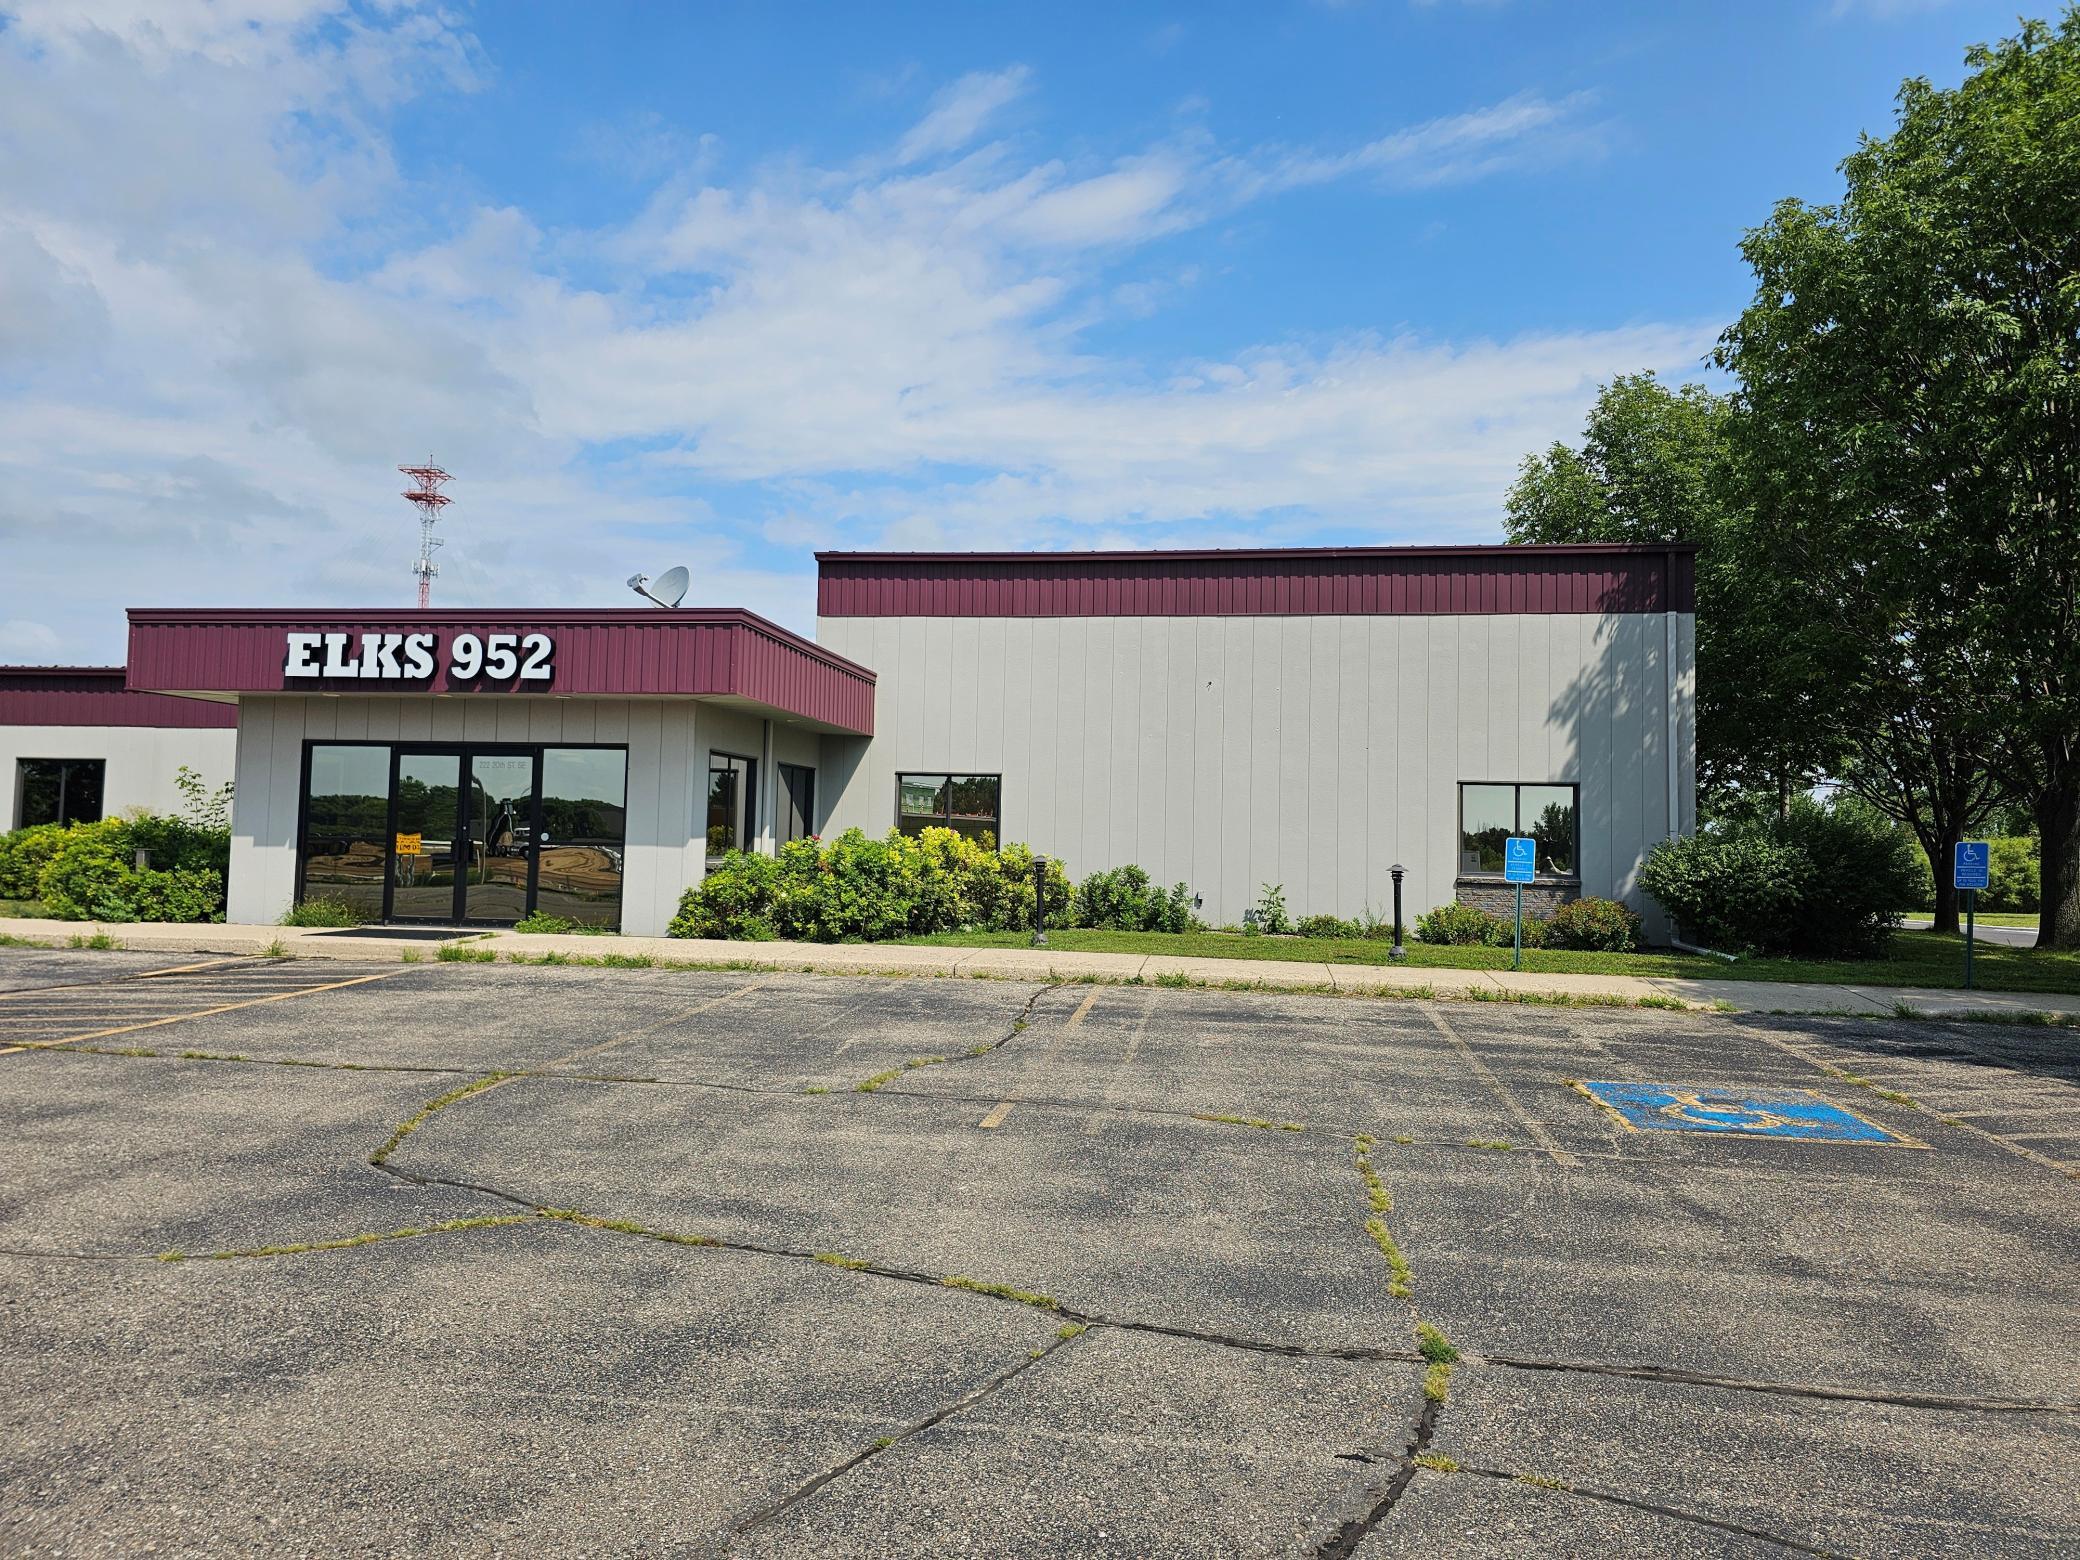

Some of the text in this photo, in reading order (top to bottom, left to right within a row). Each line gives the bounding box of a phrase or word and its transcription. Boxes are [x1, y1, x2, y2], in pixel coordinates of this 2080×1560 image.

[285, 632, 552, 680] ELKS 952
[479, 760, 490, 769] 222
